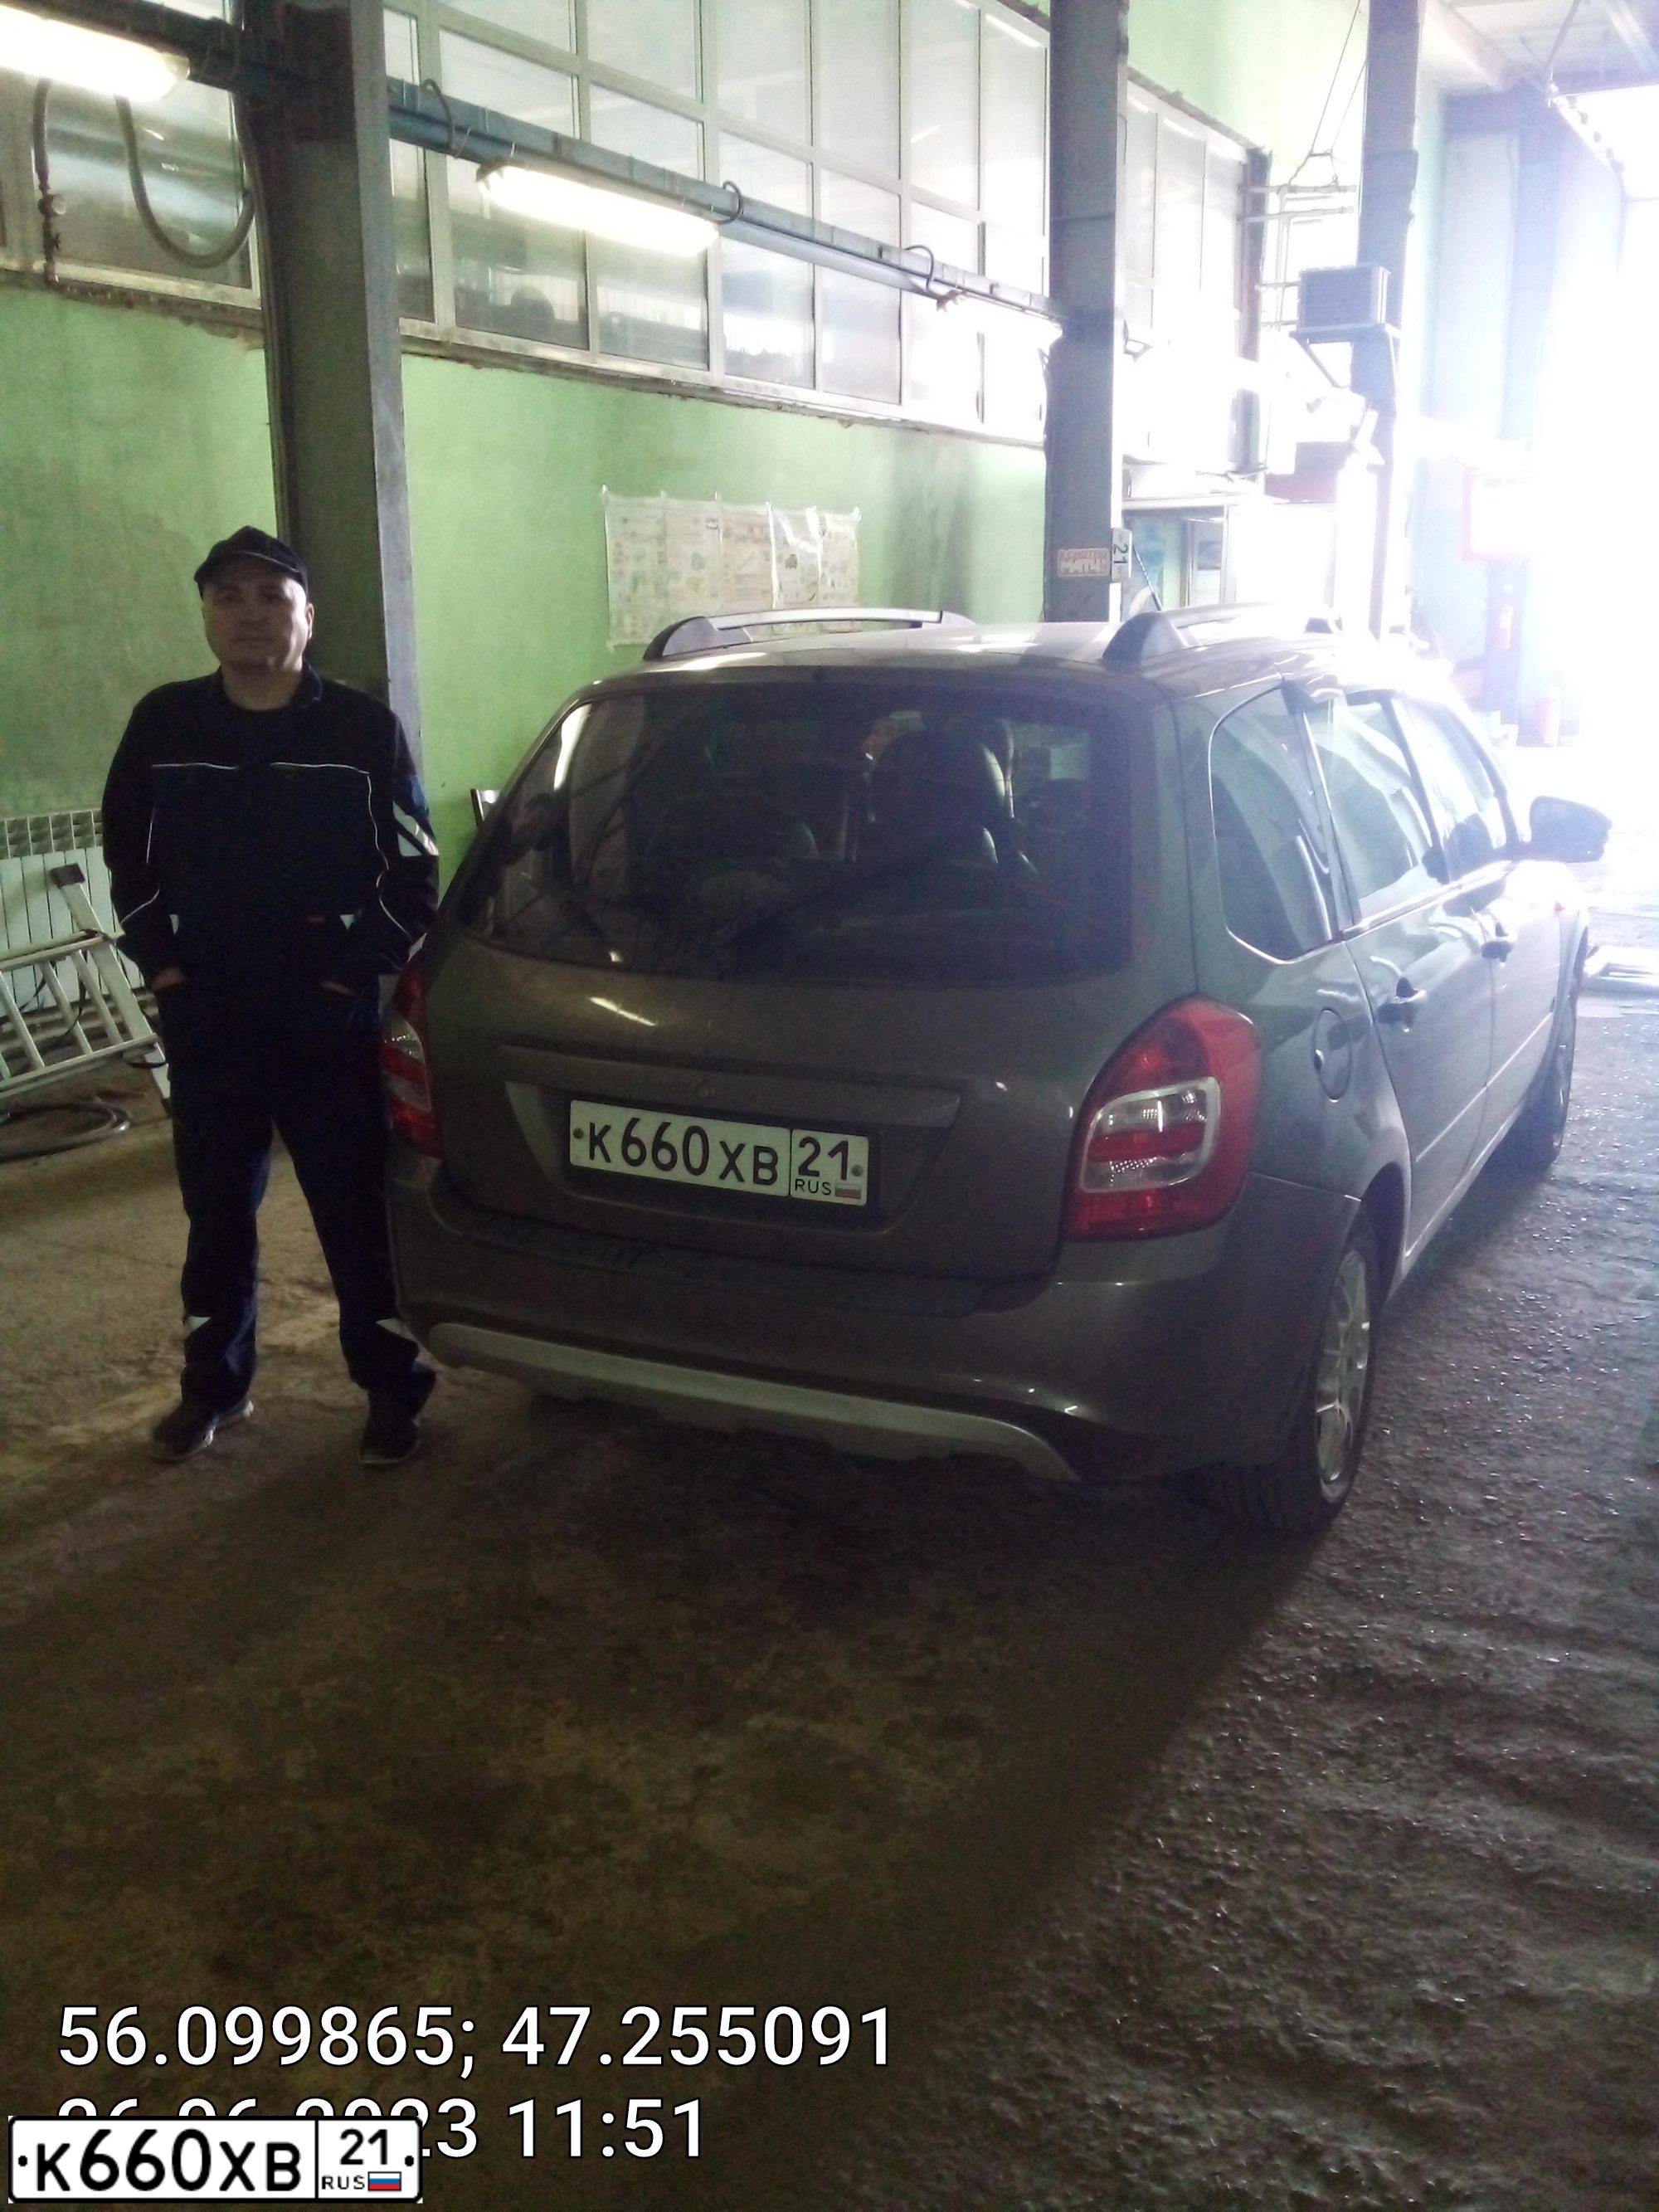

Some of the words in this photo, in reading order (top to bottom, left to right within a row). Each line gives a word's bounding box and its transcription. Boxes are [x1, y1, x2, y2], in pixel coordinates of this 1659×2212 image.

[588, 1117, 779, 1186] К660ХВ
[798, 1136, 849, 1181] 21
[795, 1178, 831, 1196] RUS
